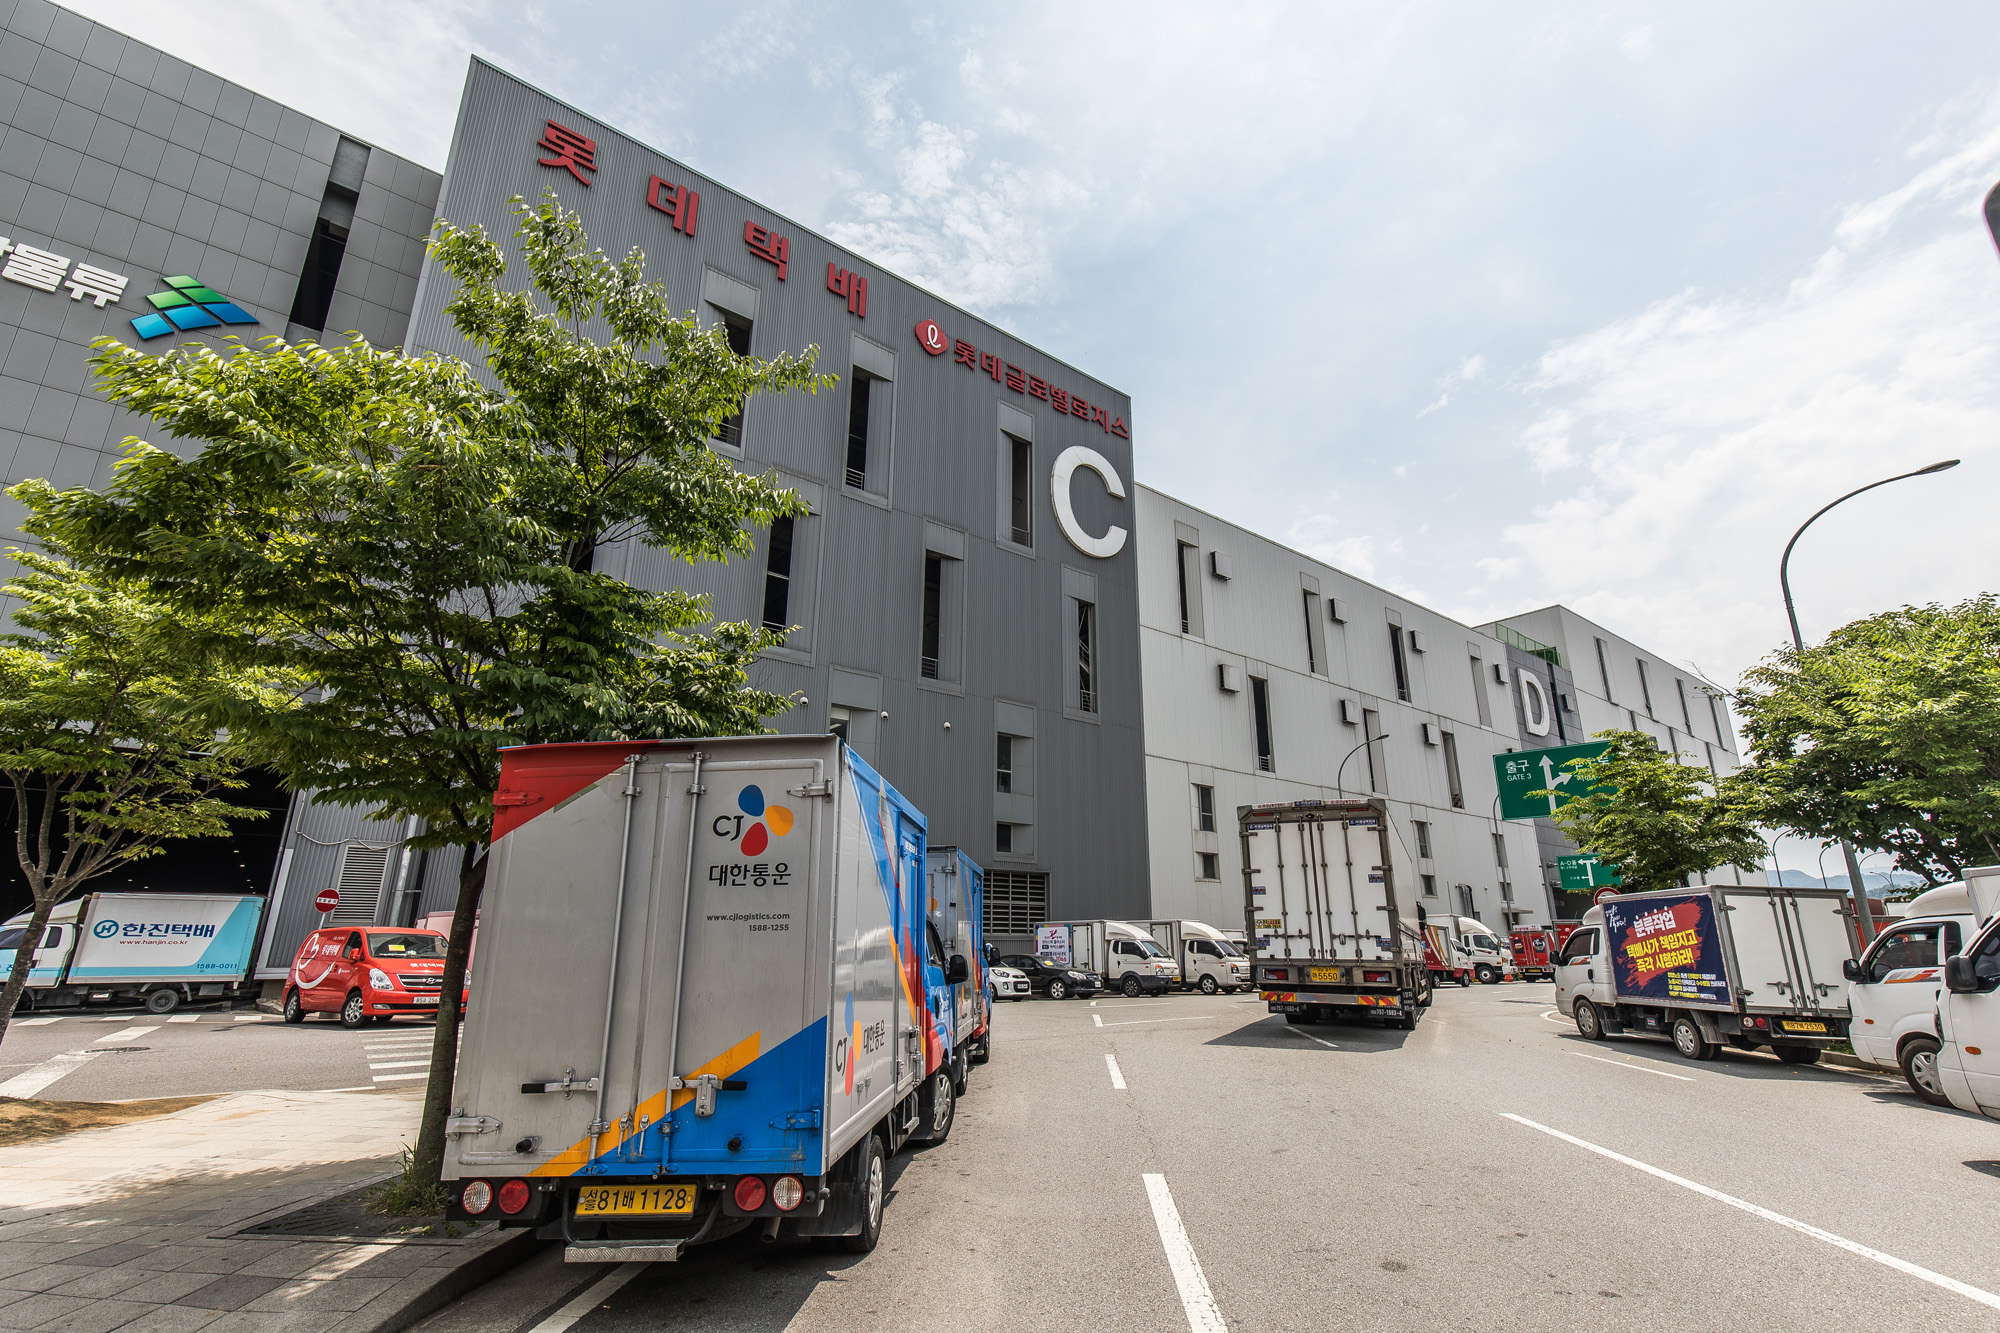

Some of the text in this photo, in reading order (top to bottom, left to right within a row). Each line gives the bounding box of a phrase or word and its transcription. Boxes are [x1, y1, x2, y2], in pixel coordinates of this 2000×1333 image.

[0, 236, 130, 309] 물류
[954, 338, 1129, 440] 롯데글로벌로지스
[1051, 445, 1128, 559] C
[1517, 667, 1551, 737] D
[1506, 760, 1529, 774] 출구
[712, 815, 745, 842] CJ
[709, 862, 792, 888] 대한통운
[122, 923, 216, 938] 한진택배
[706, 912, 790, 922] www.cjlogistics.com
[748, 924, 790, 932] 1588-1255
[1633, 909, 1677, 938] 분류작업
[1626, 929, 1698, 959] 택배사가 책임지고
[1636, 947, 1695, 973] 즉각 시행하라!
[863, 1019, 885, 1055] 대한통운
[836, 1037, 848, 1076] CJ
[640, 1188, 688, 1211] 1128
